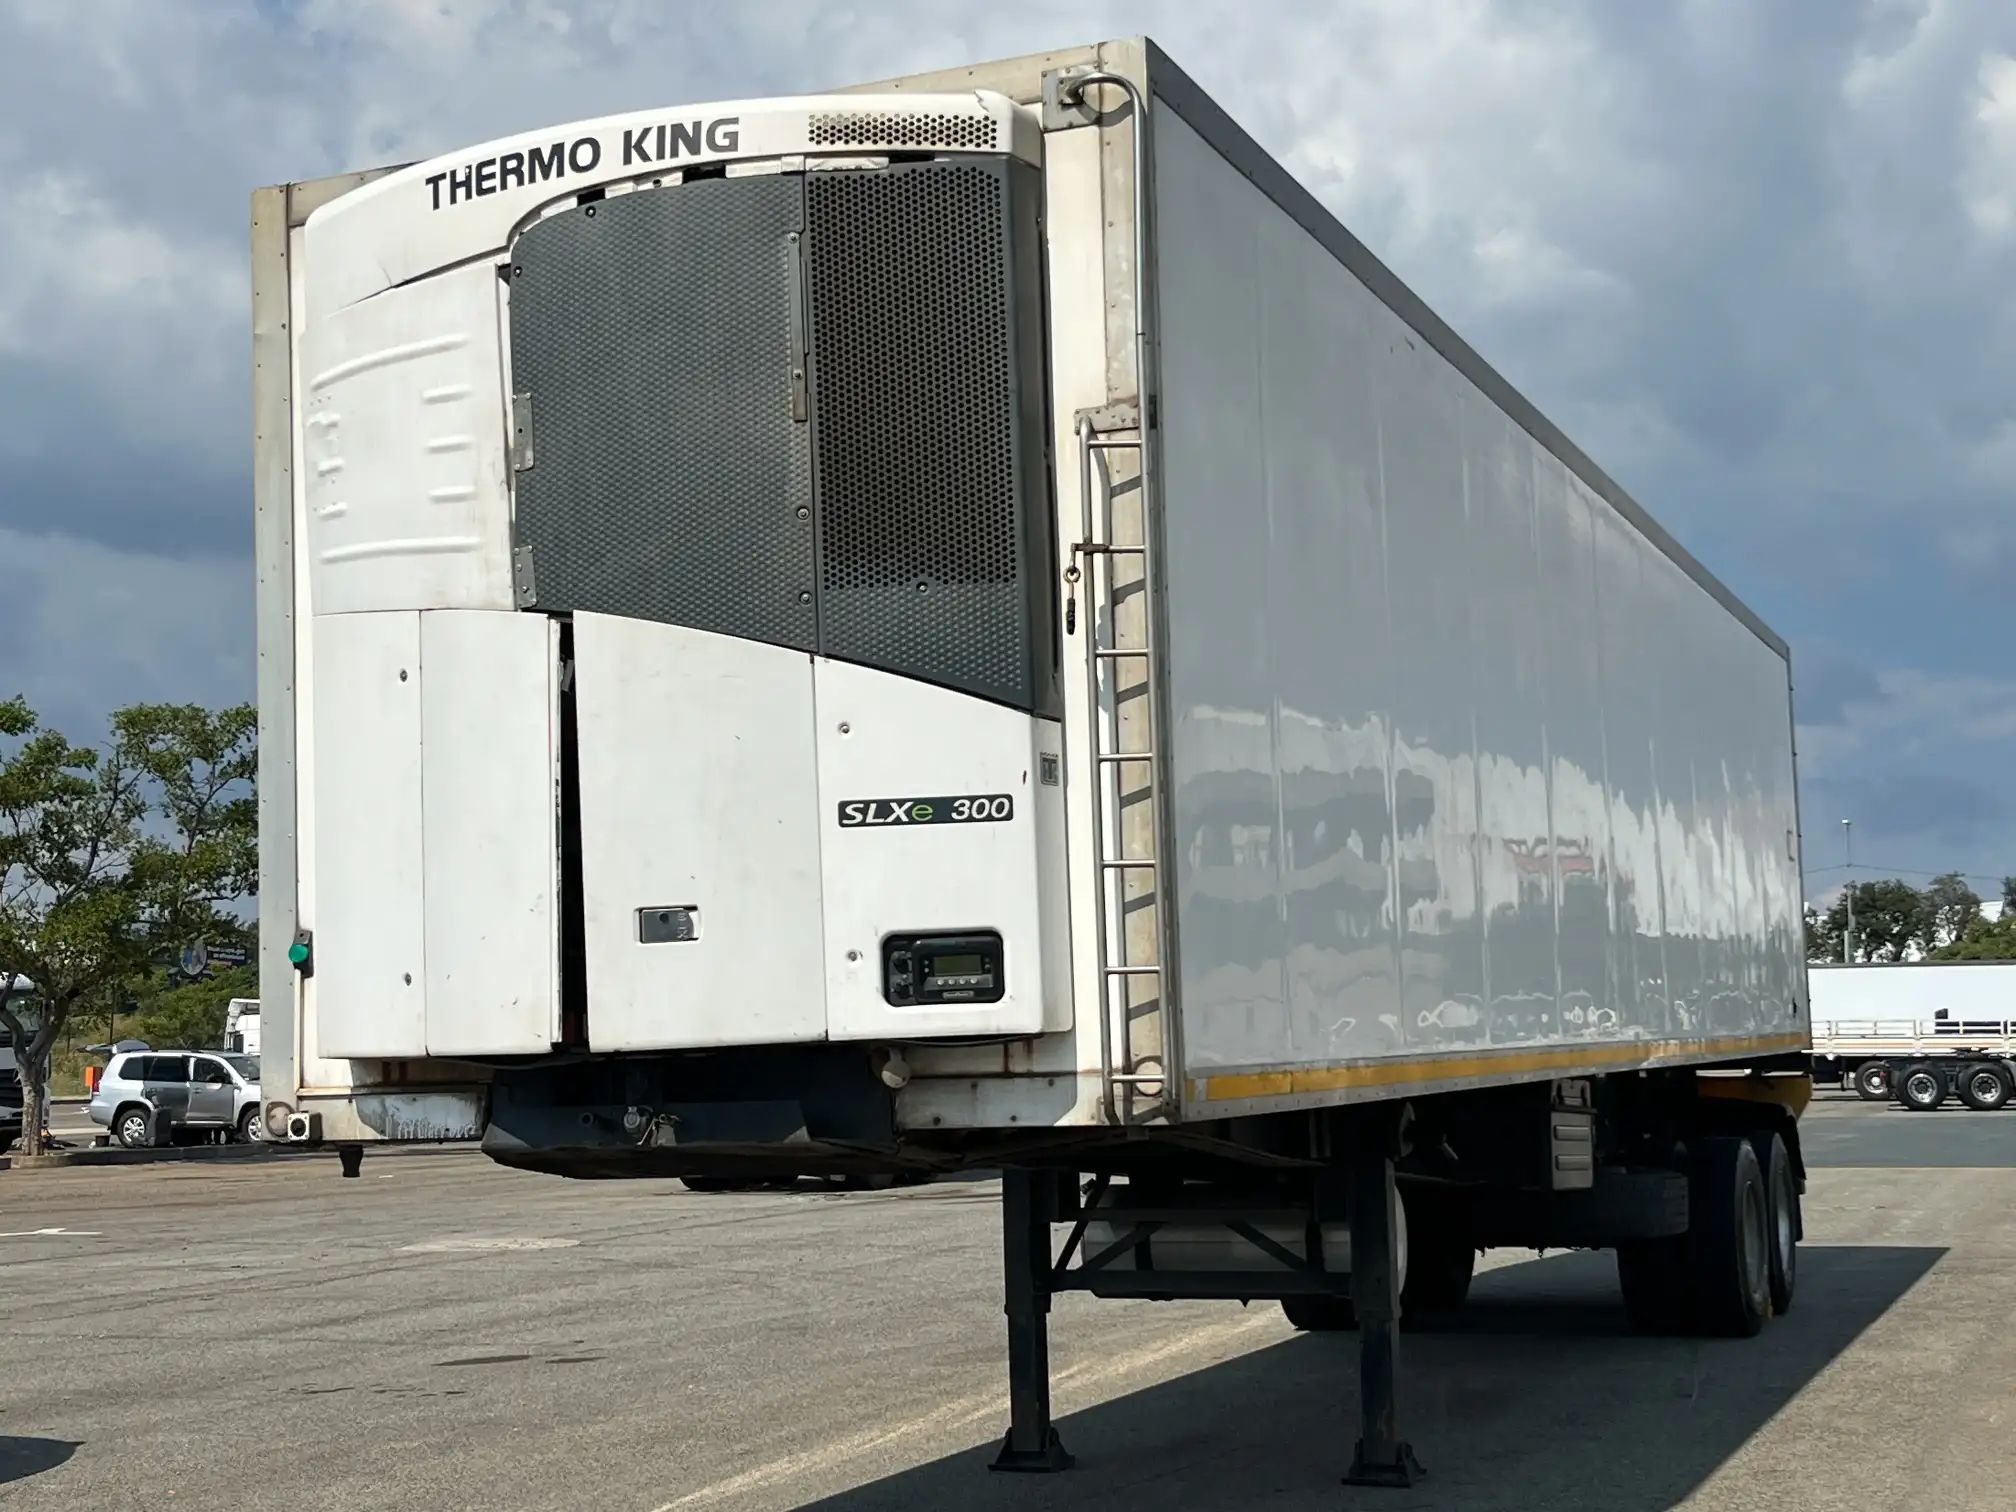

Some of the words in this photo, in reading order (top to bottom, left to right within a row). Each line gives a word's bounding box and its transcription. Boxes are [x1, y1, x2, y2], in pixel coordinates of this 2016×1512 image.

[425, 137, 601, 210] THERMO
[623, 117, 739, 165] KING
[842, 801, 934, 824] SLXe
[951, 797, 1010, 820] 300
